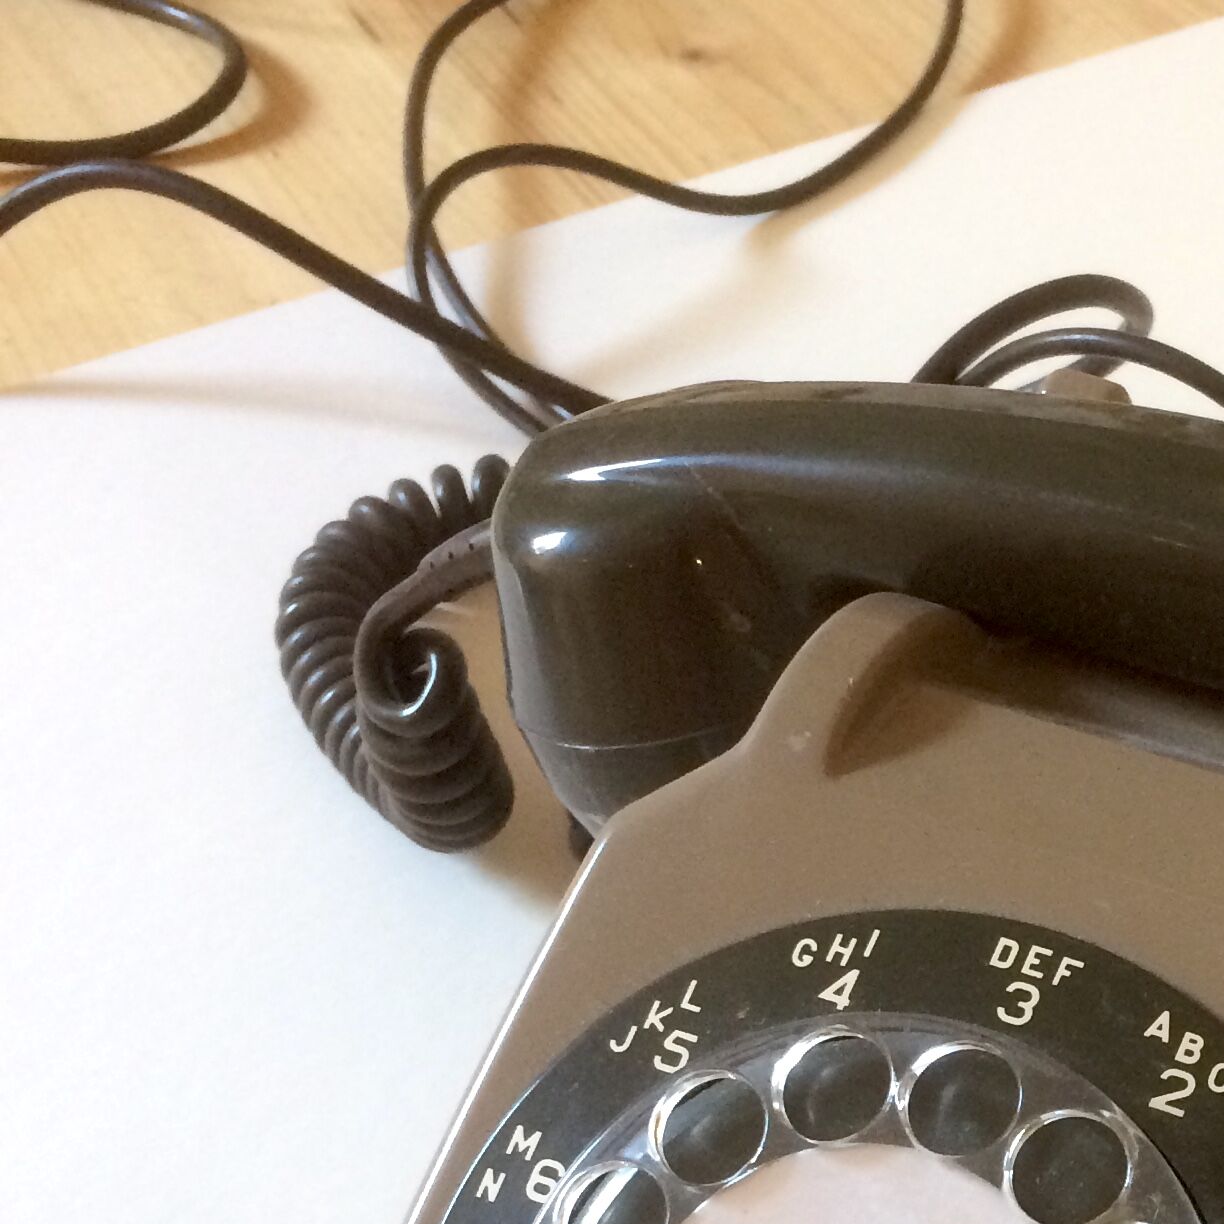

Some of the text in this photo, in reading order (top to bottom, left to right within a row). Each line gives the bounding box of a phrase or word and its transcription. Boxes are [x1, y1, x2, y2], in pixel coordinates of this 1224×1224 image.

[791, 929, 881, 967] GHI
[989, 937, 1085, 986] DEF
[818, 969, 862, 1010] 4
[996, 981, 1040, 1026] 3
[609, 980, 702, 1053] JKL
[653, 1030, 698, 1074] 5
[1148, 1069, 1196, 1118] 2
[526, 1159, 567, 1205] 6
